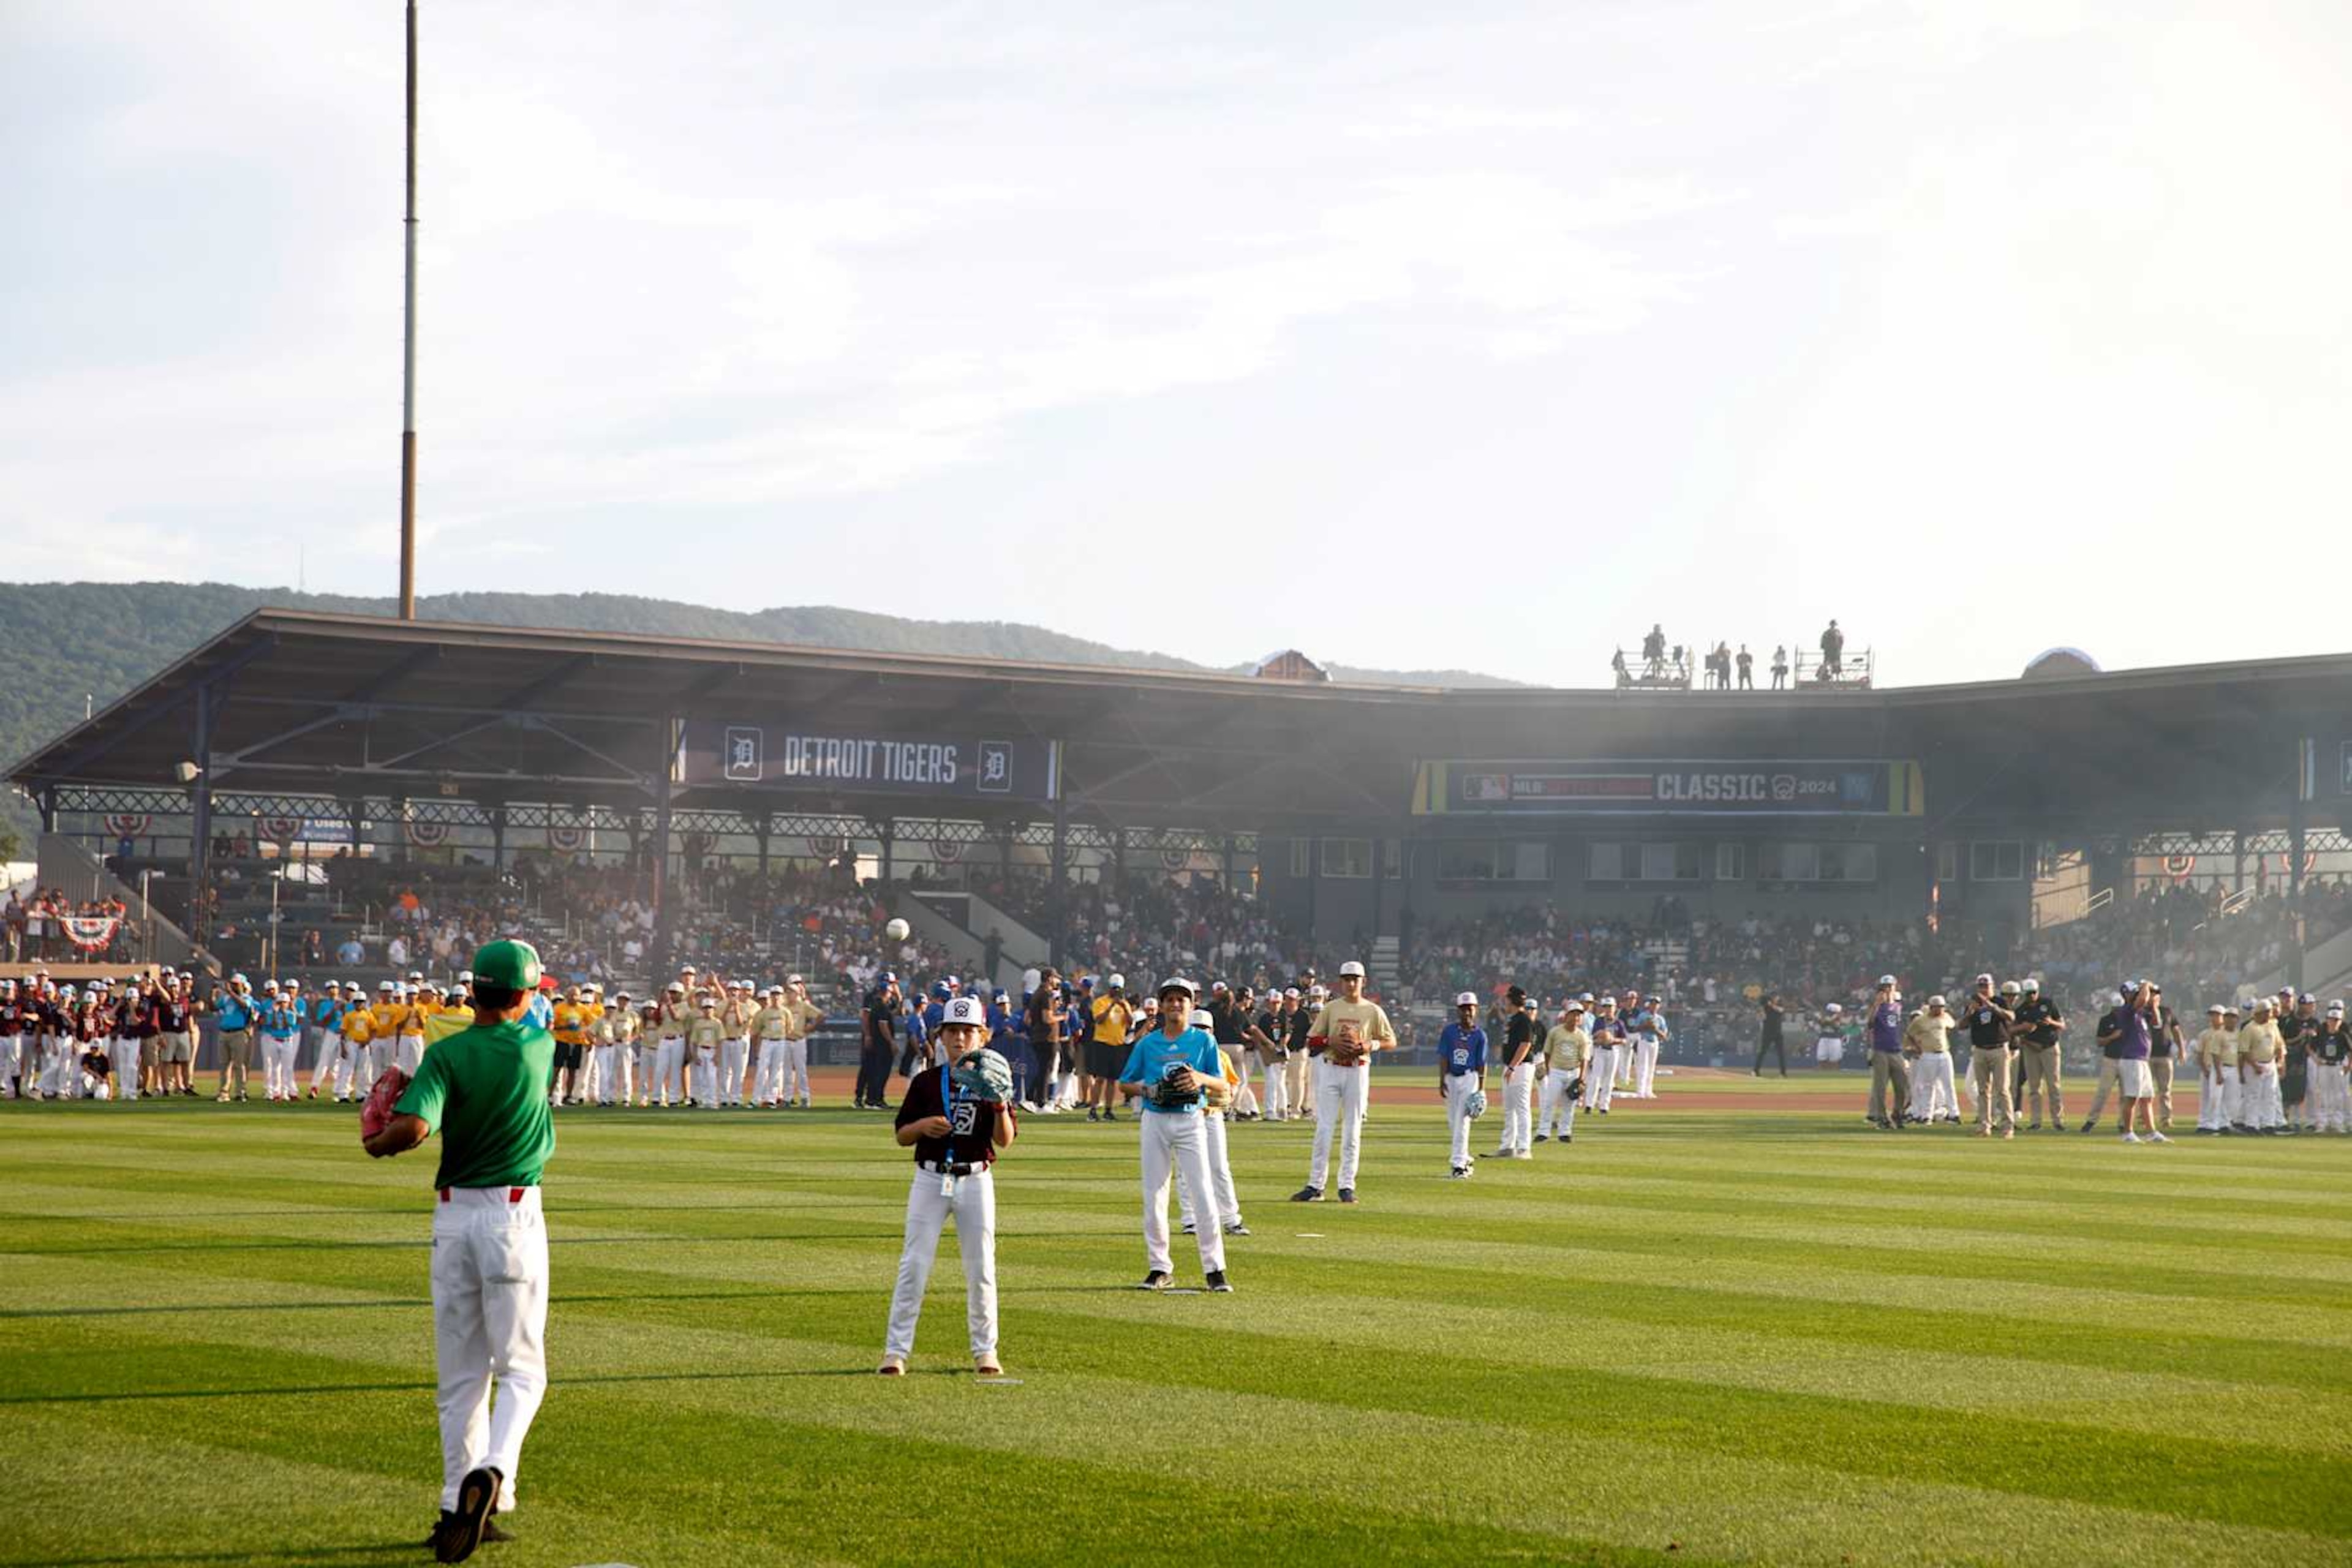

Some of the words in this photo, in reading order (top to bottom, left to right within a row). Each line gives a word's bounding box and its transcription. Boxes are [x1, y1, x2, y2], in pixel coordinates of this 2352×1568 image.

[785, 736, 876, 779] DETROIT
[881, 741, 957, 784] TIGERS
[1656, 774, 1766, 801] CLASSIC
[1799, 779, 1836, 794] 2024
